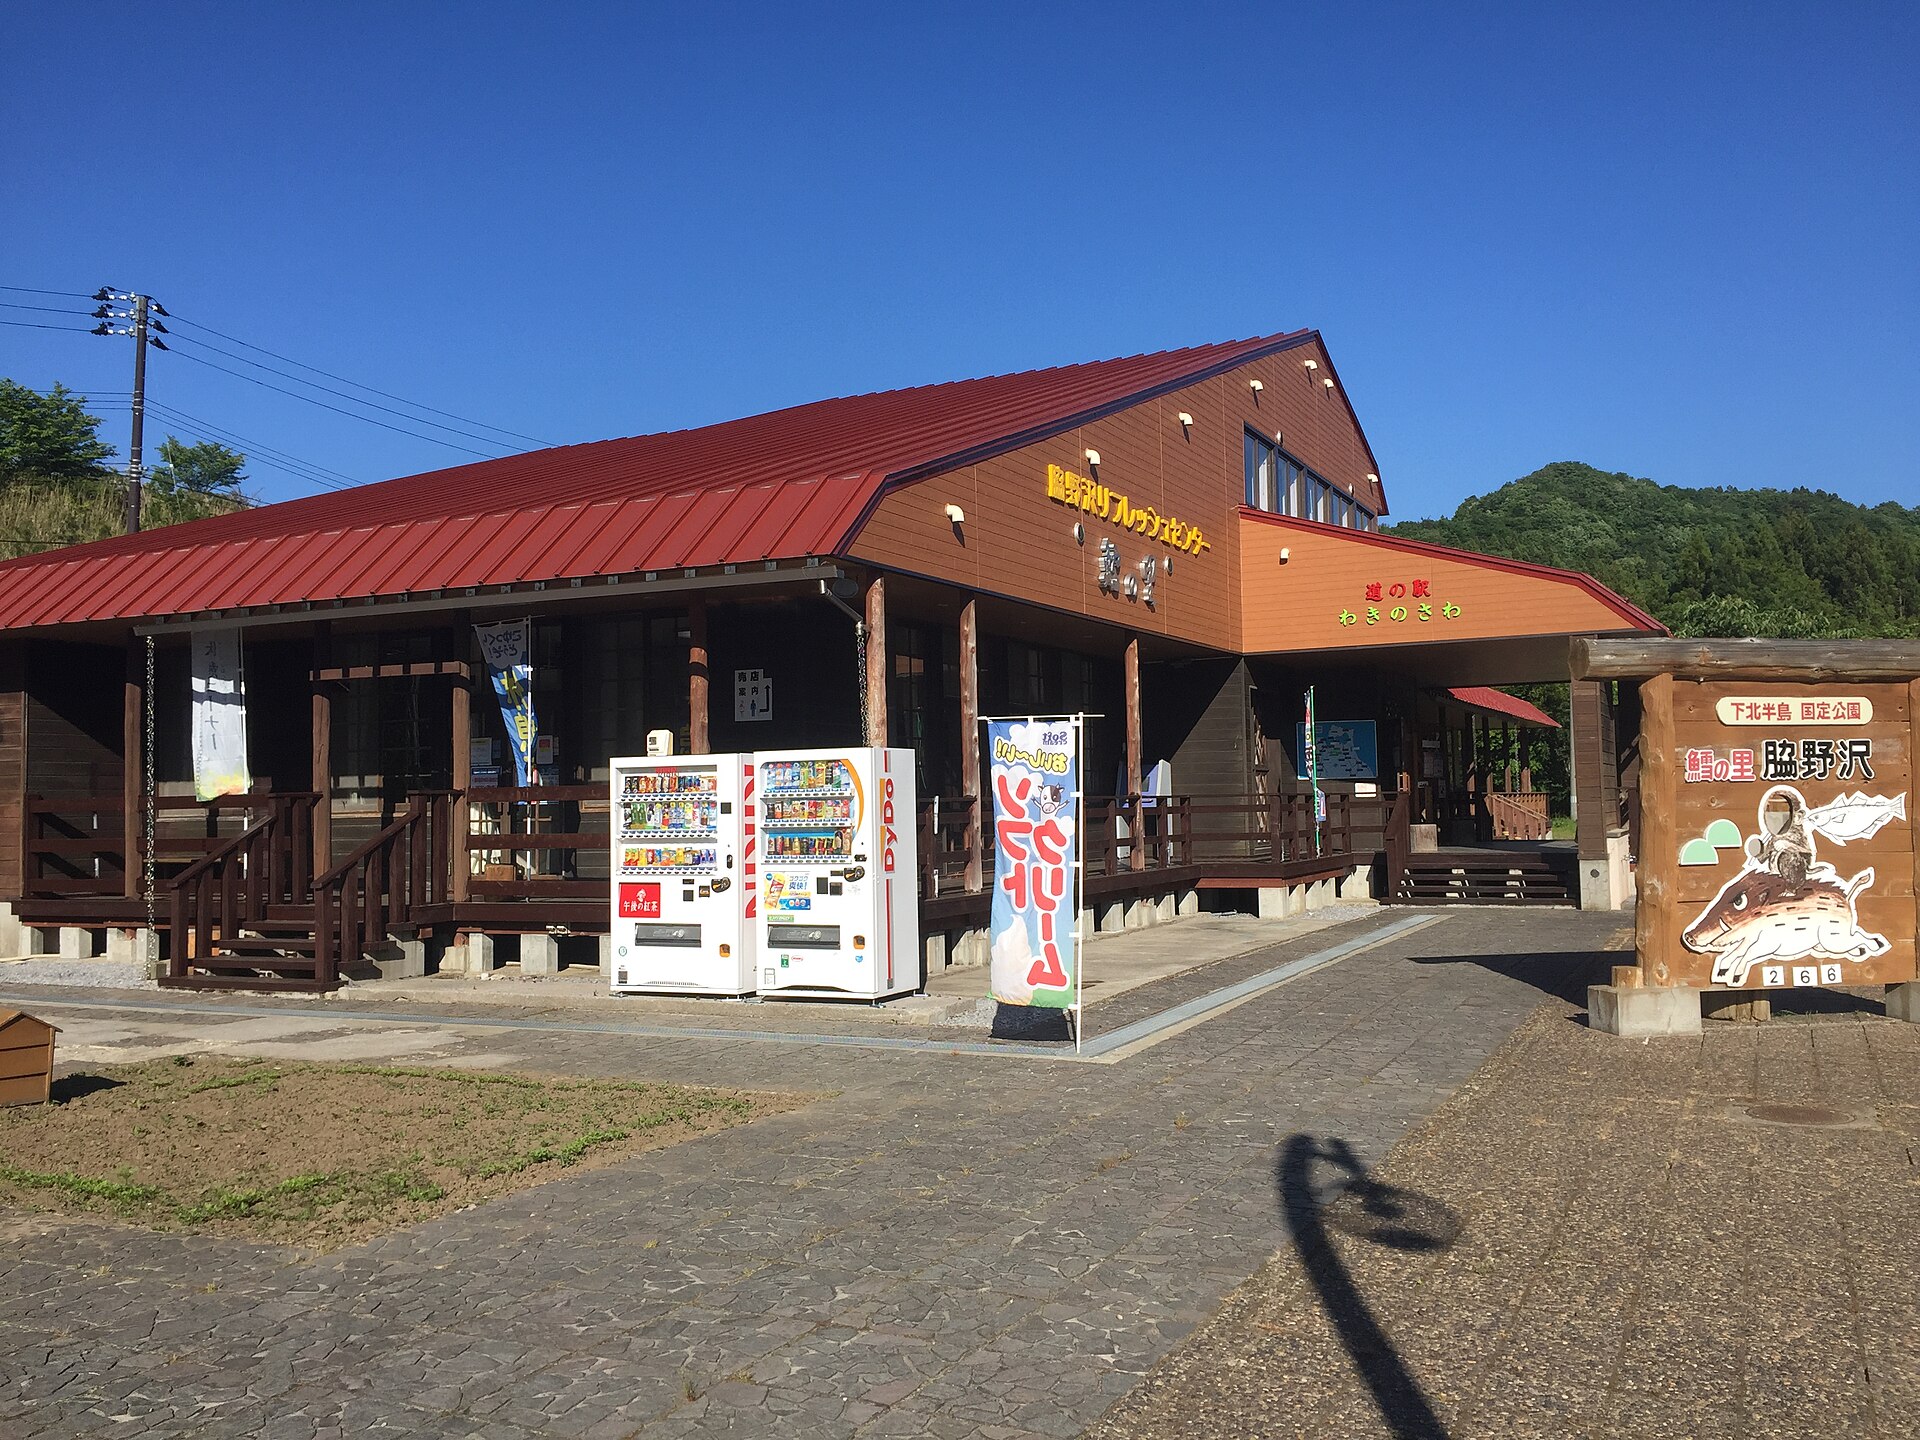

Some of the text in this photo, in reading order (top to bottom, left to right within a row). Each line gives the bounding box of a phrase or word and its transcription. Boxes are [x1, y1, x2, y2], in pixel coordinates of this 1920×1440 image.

[1365, 579, 1431, 602] 道の駅
[1339, 601, 1461, 627] わきのさわ
[738, 671, 759, 682] 売店
[738, 686, 759, 697] 案内
[1730, 701, 1861, 721] 下北半島 国定公園
[1686, 739, 1875, 782] 鱈の里 脇野沢
[623, 900, 658, 912] 午後の紅茶
